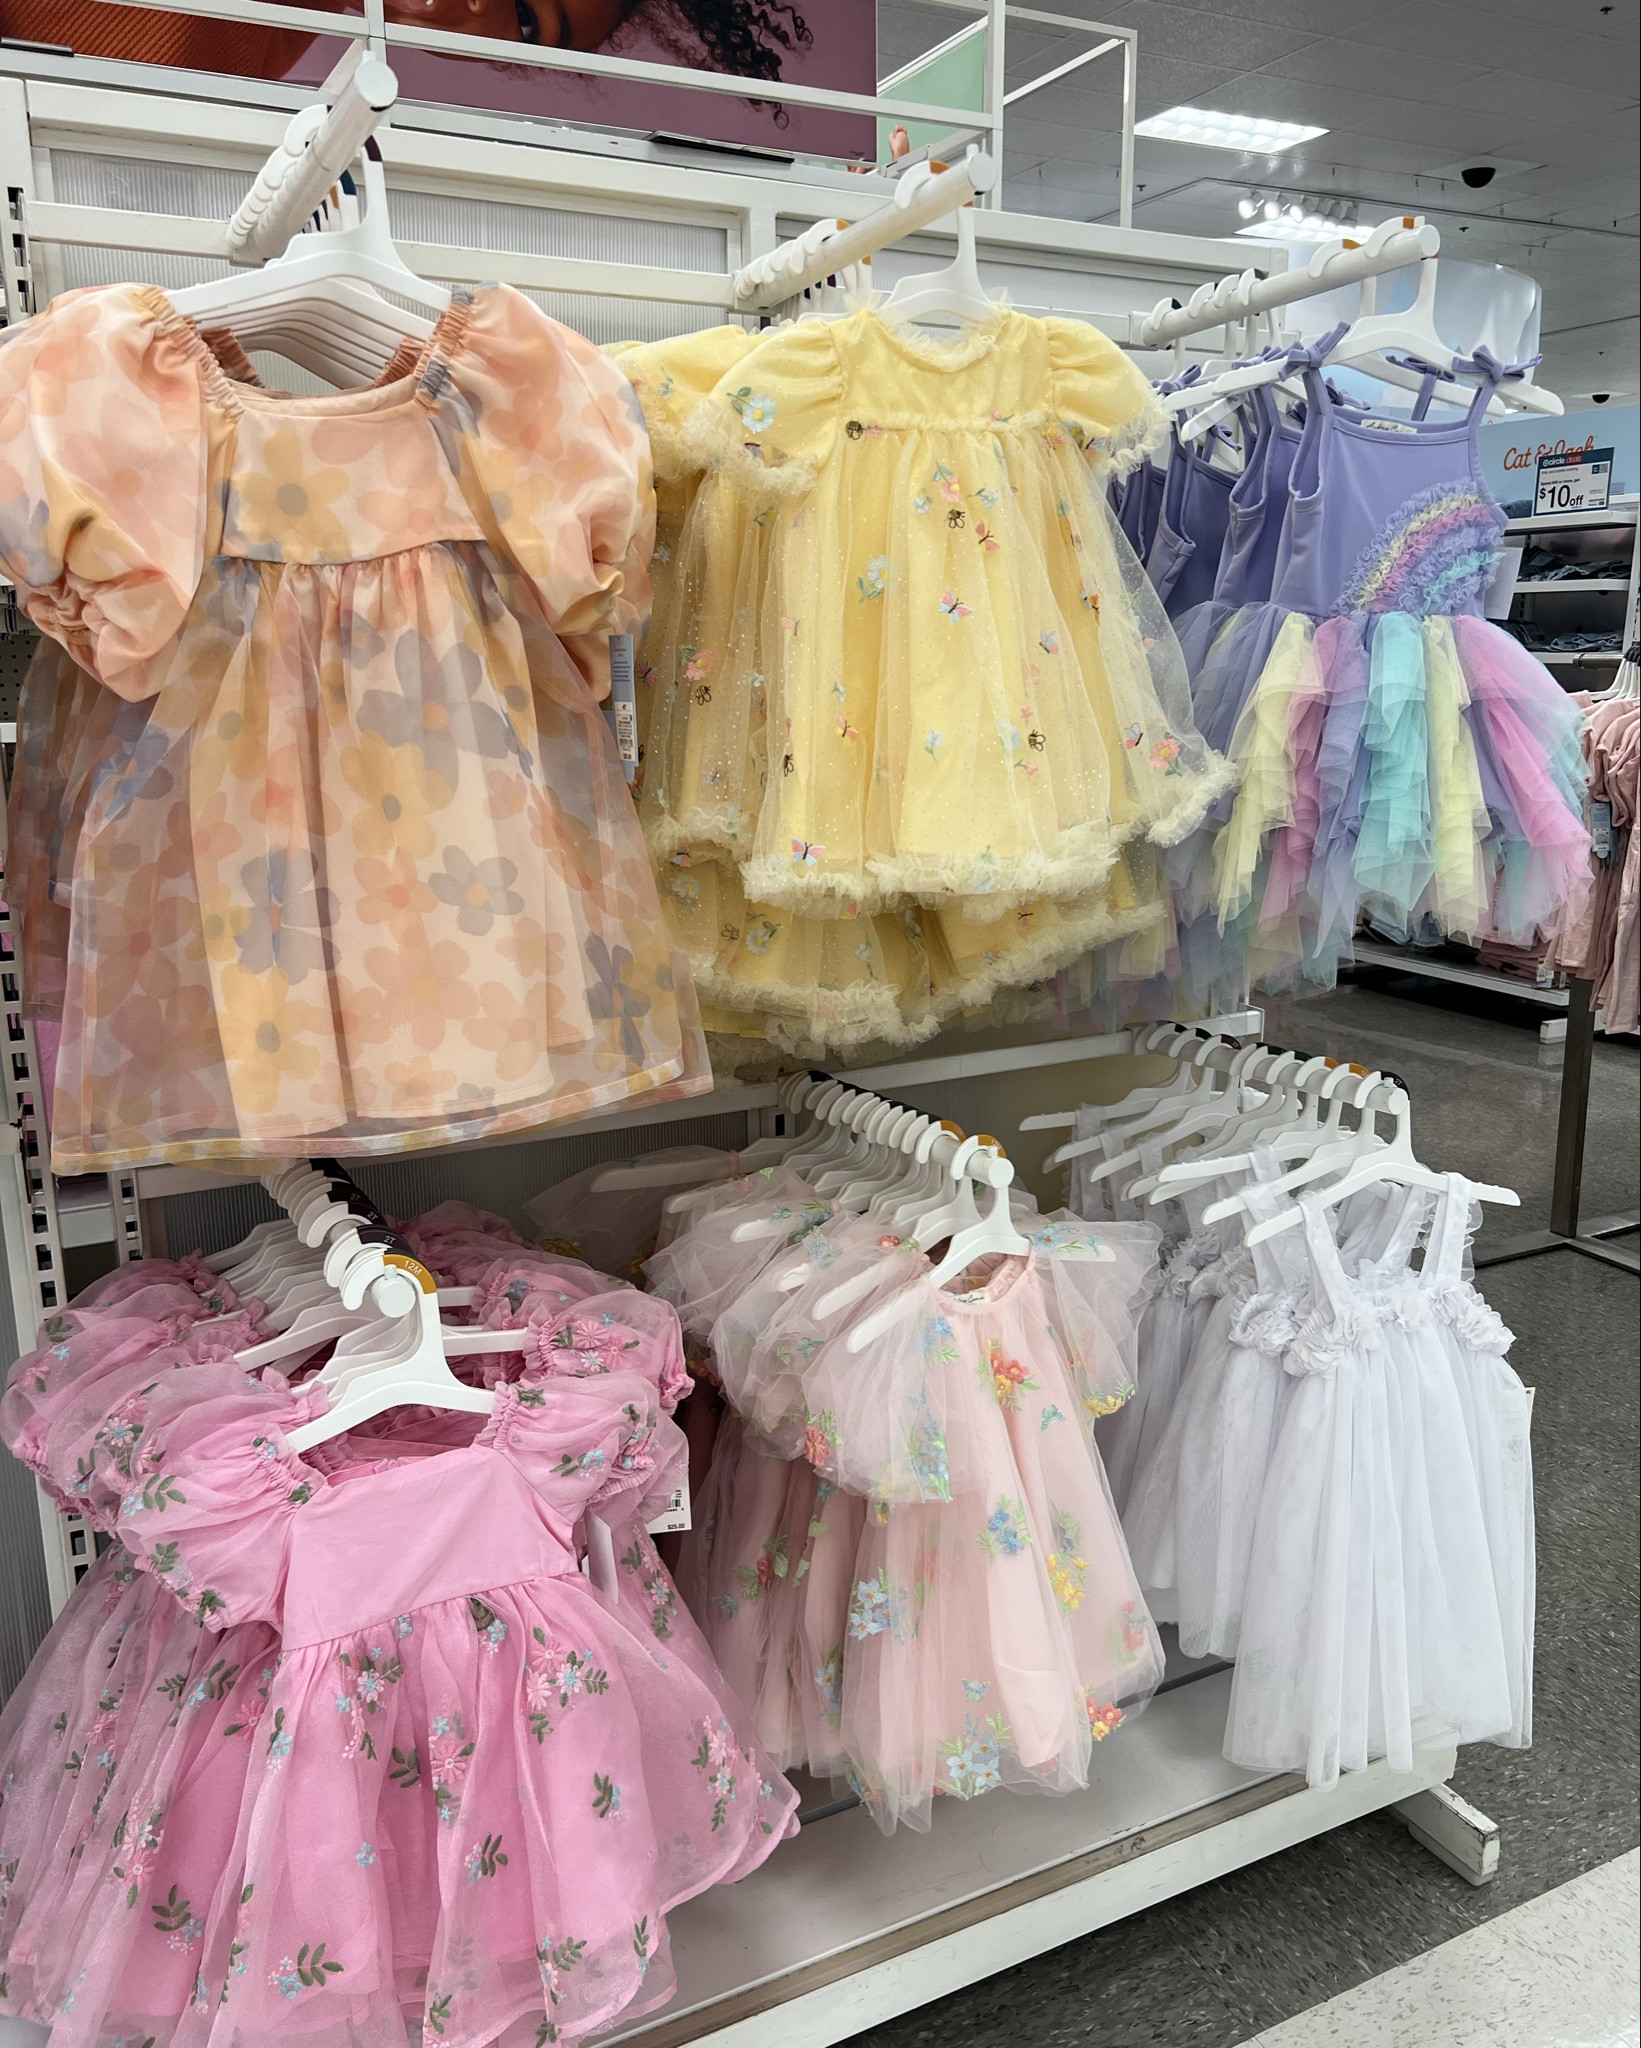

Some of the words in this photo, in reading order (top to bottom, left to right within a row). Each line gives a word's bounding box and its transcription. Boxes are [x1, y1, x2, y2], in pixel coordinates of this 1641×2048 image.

[1504, 448, 1532, 470] Cat
[1549, 458, 1566, 466] circle
[1540, 485, 1570, 508] $10
[1570, 495, 1584, 506] off
[367, 1212, 378, 1220] 2T
[384, 1236, 396, 1244] 2T
[404, 1260, 422, 1276] 12M
[667, 1522, 686, 1531] $25.00
